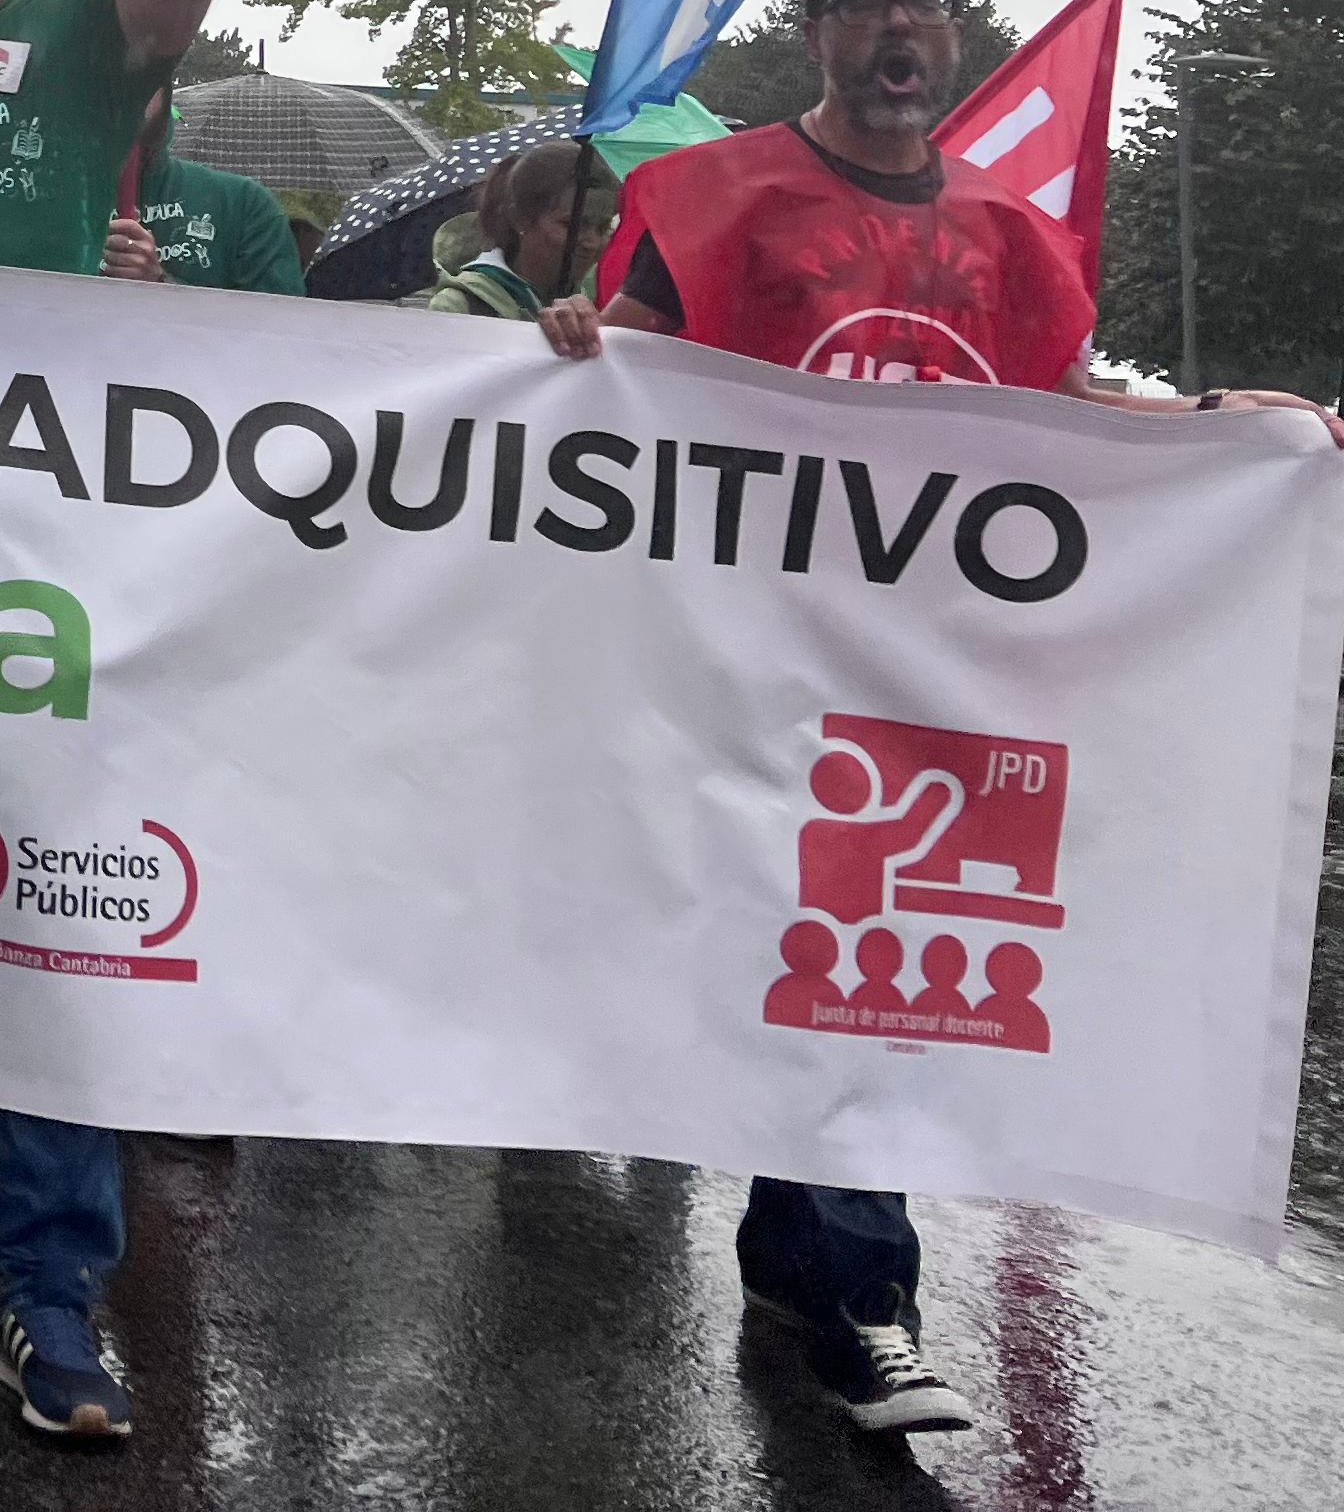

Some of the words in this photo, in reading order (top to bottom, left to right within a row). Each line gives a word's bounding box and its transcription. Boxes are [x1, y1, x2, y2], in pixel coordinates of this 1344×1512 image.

[979, 749, 1048, 797] JPD
[16, 836, 161, 881] Servicios
[15, 877, 152, 923] Públicos
